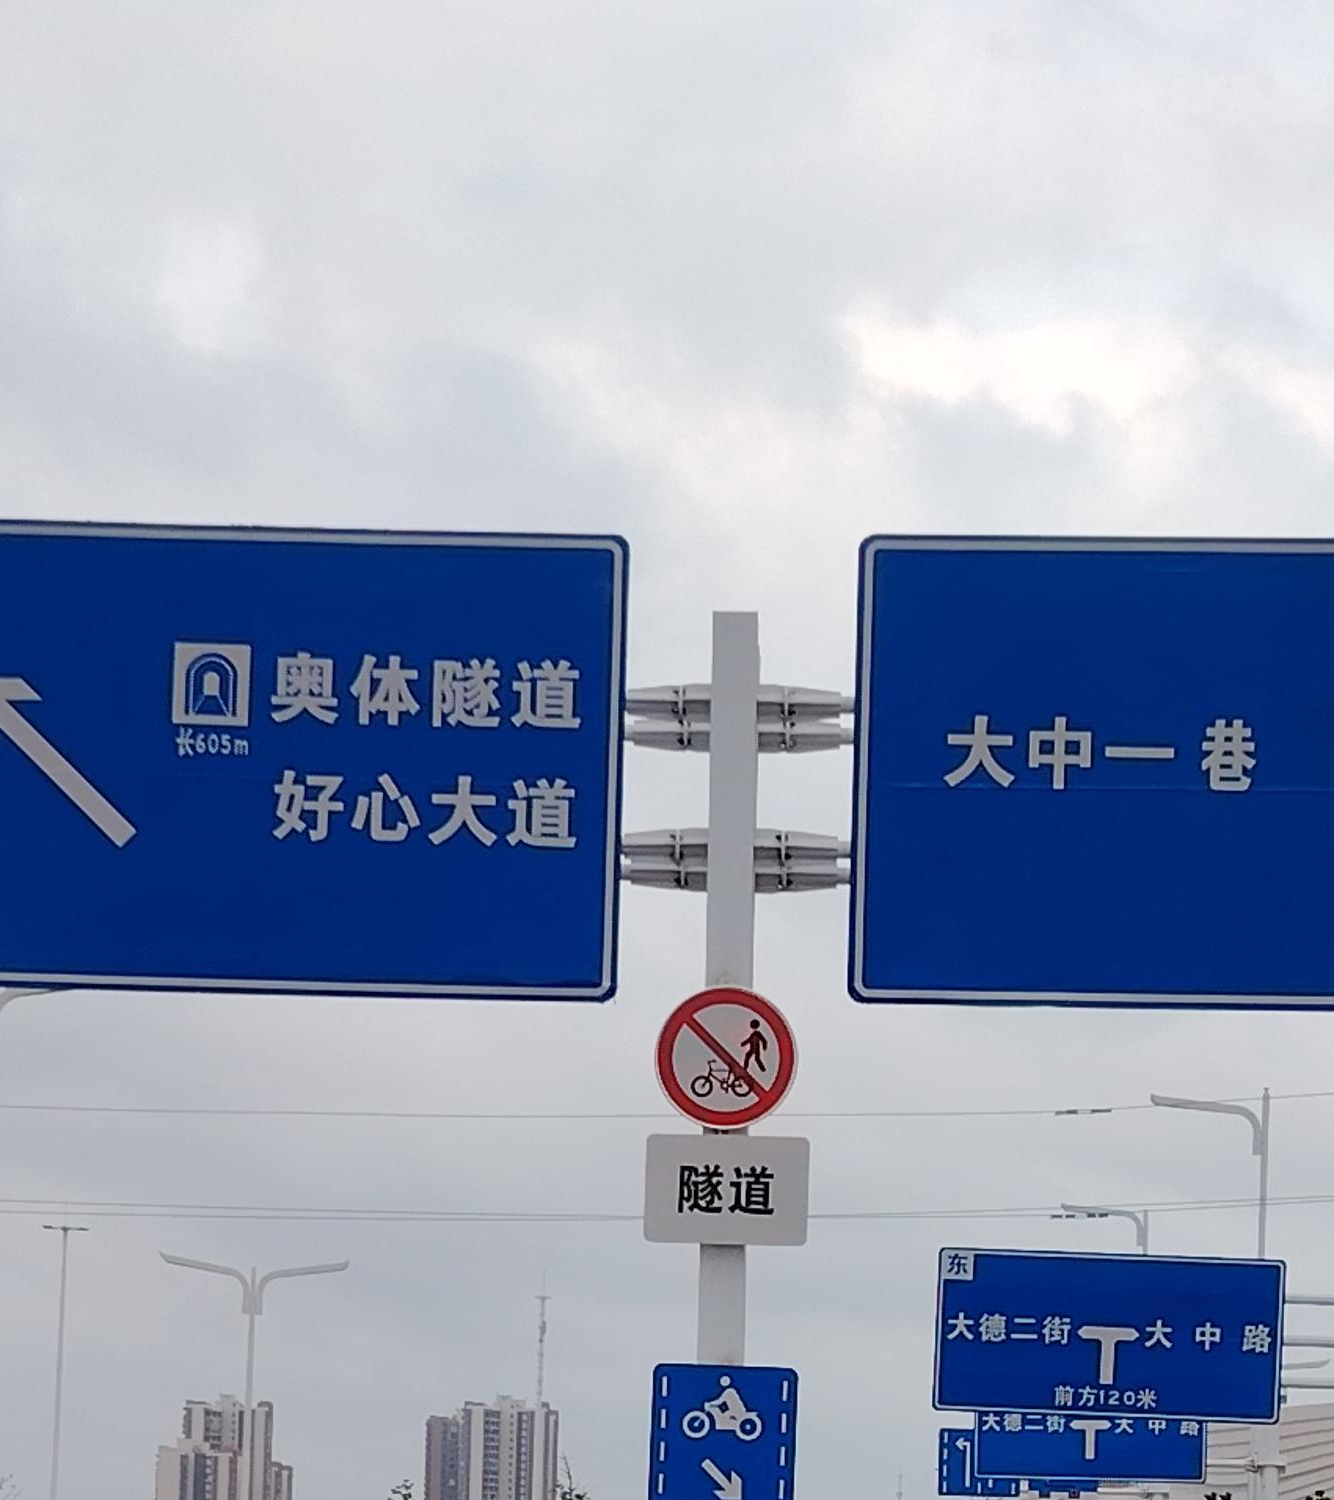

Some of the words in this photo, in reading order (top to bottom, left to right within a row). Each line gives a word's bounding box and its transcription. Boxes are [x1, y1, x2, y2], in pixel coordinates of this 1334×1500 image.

[270, 652, 581, 729] 奥体隧道
[942, 715, 1257, 792] 大中一巷
[272, 769, 577, 848] 好心大道
[677, 1164, 775, 1216] 隧道
[946, 1253, 968, 1275] 东
[946, 1312, 1072, 1345] 大德二街
[1054, 1385, 1158, 1409] 前方120米
